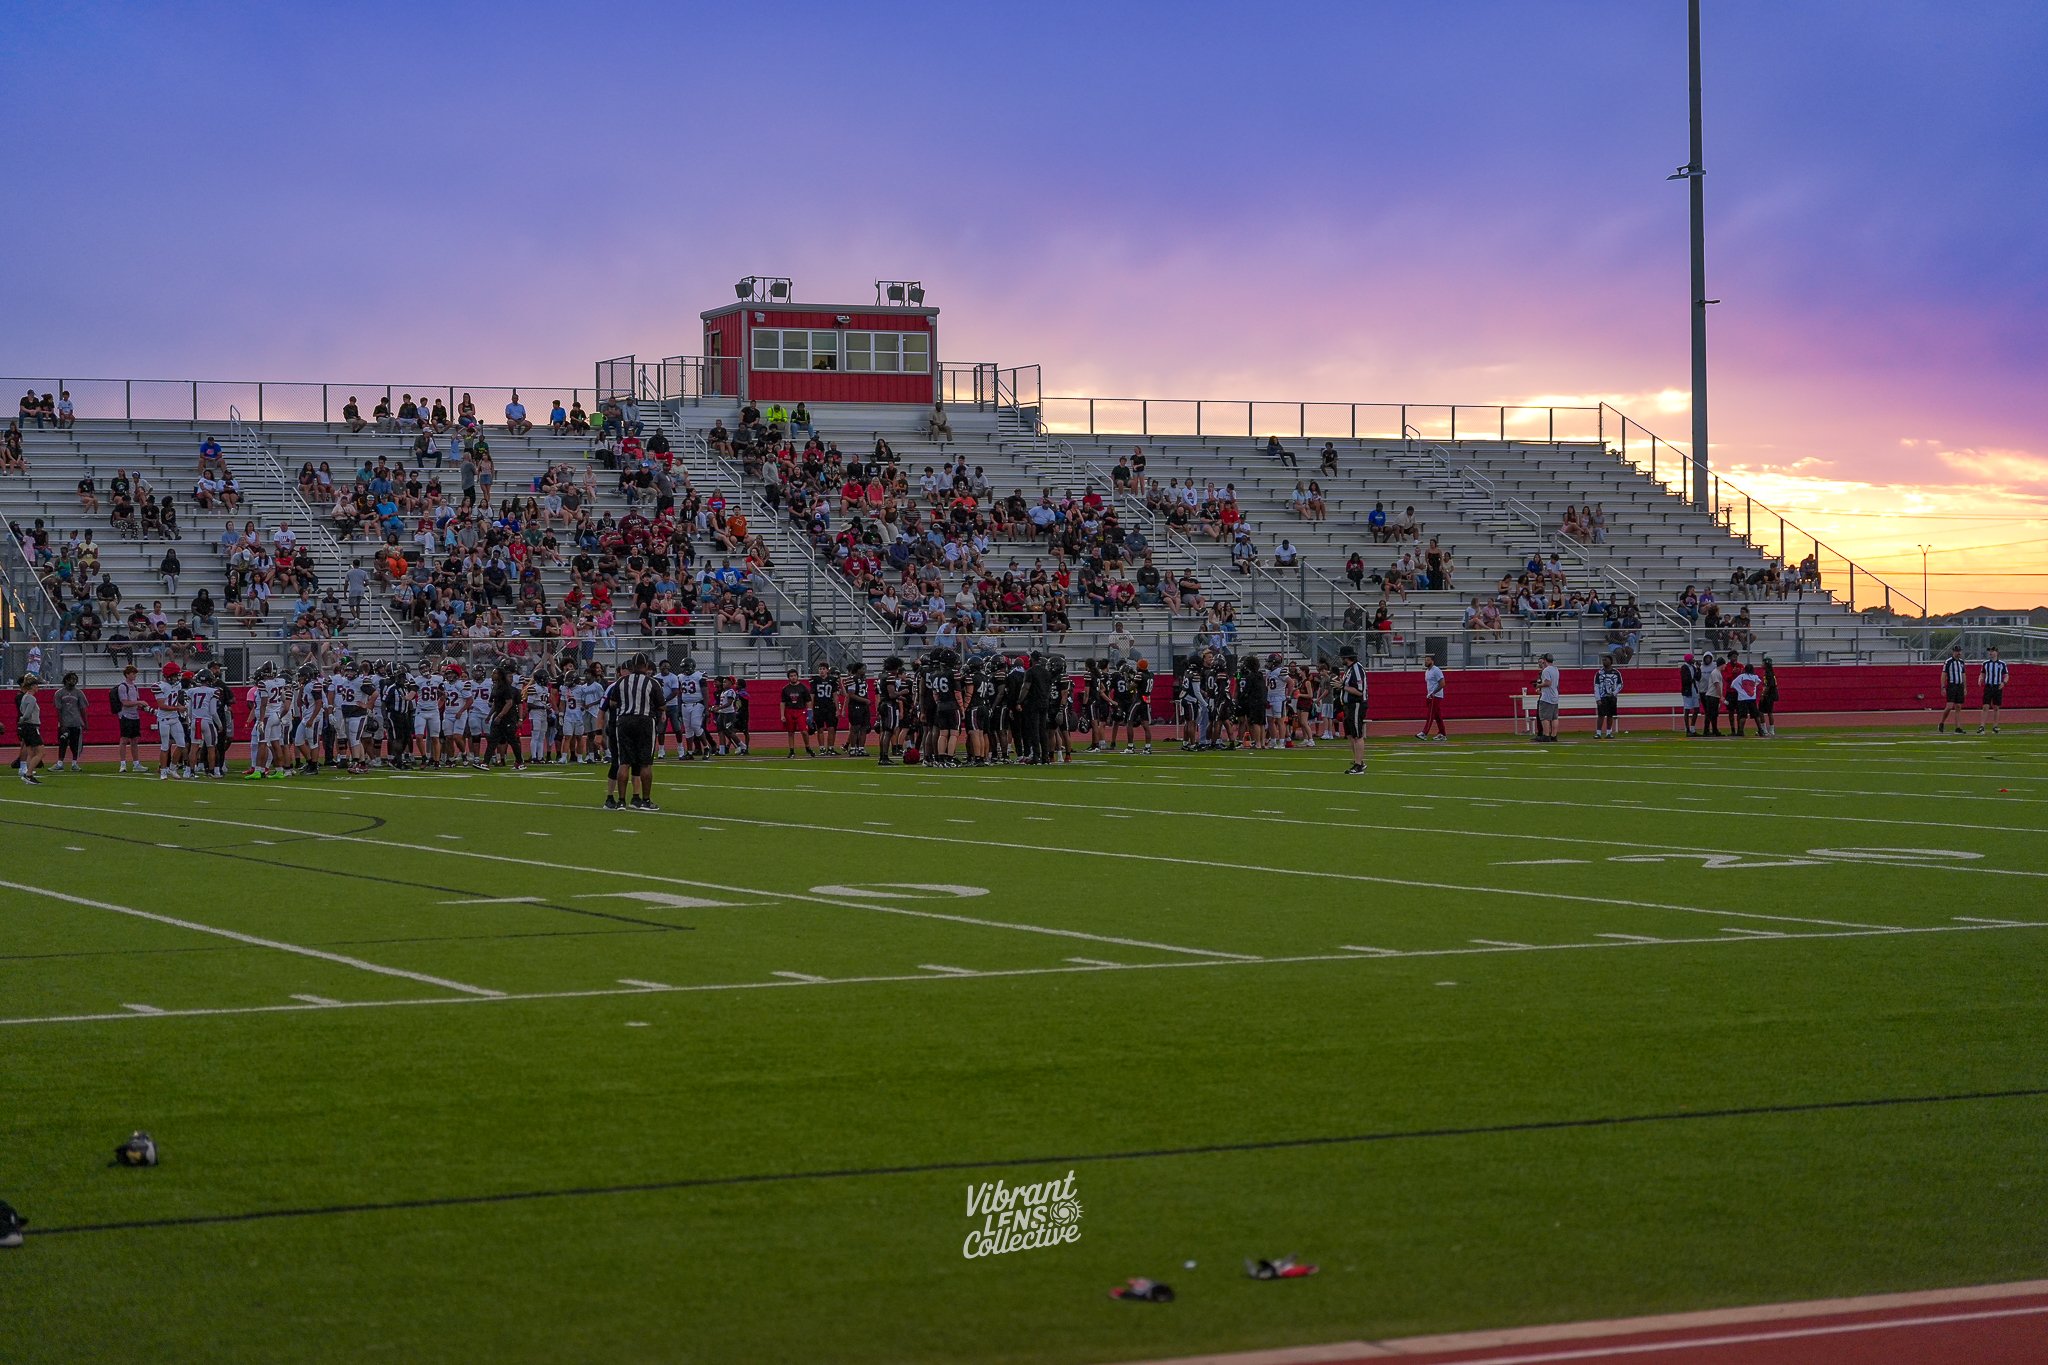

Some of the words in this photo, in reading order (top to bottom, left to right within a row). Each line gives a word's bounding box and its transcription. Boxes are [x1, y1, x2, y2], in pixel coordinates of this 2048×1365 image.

[816, 684, 832, 698] 50
[933, 677, 949, 693] 46
[193, 692, 206, 709] 17
[421, 687, 437, 702] 65
